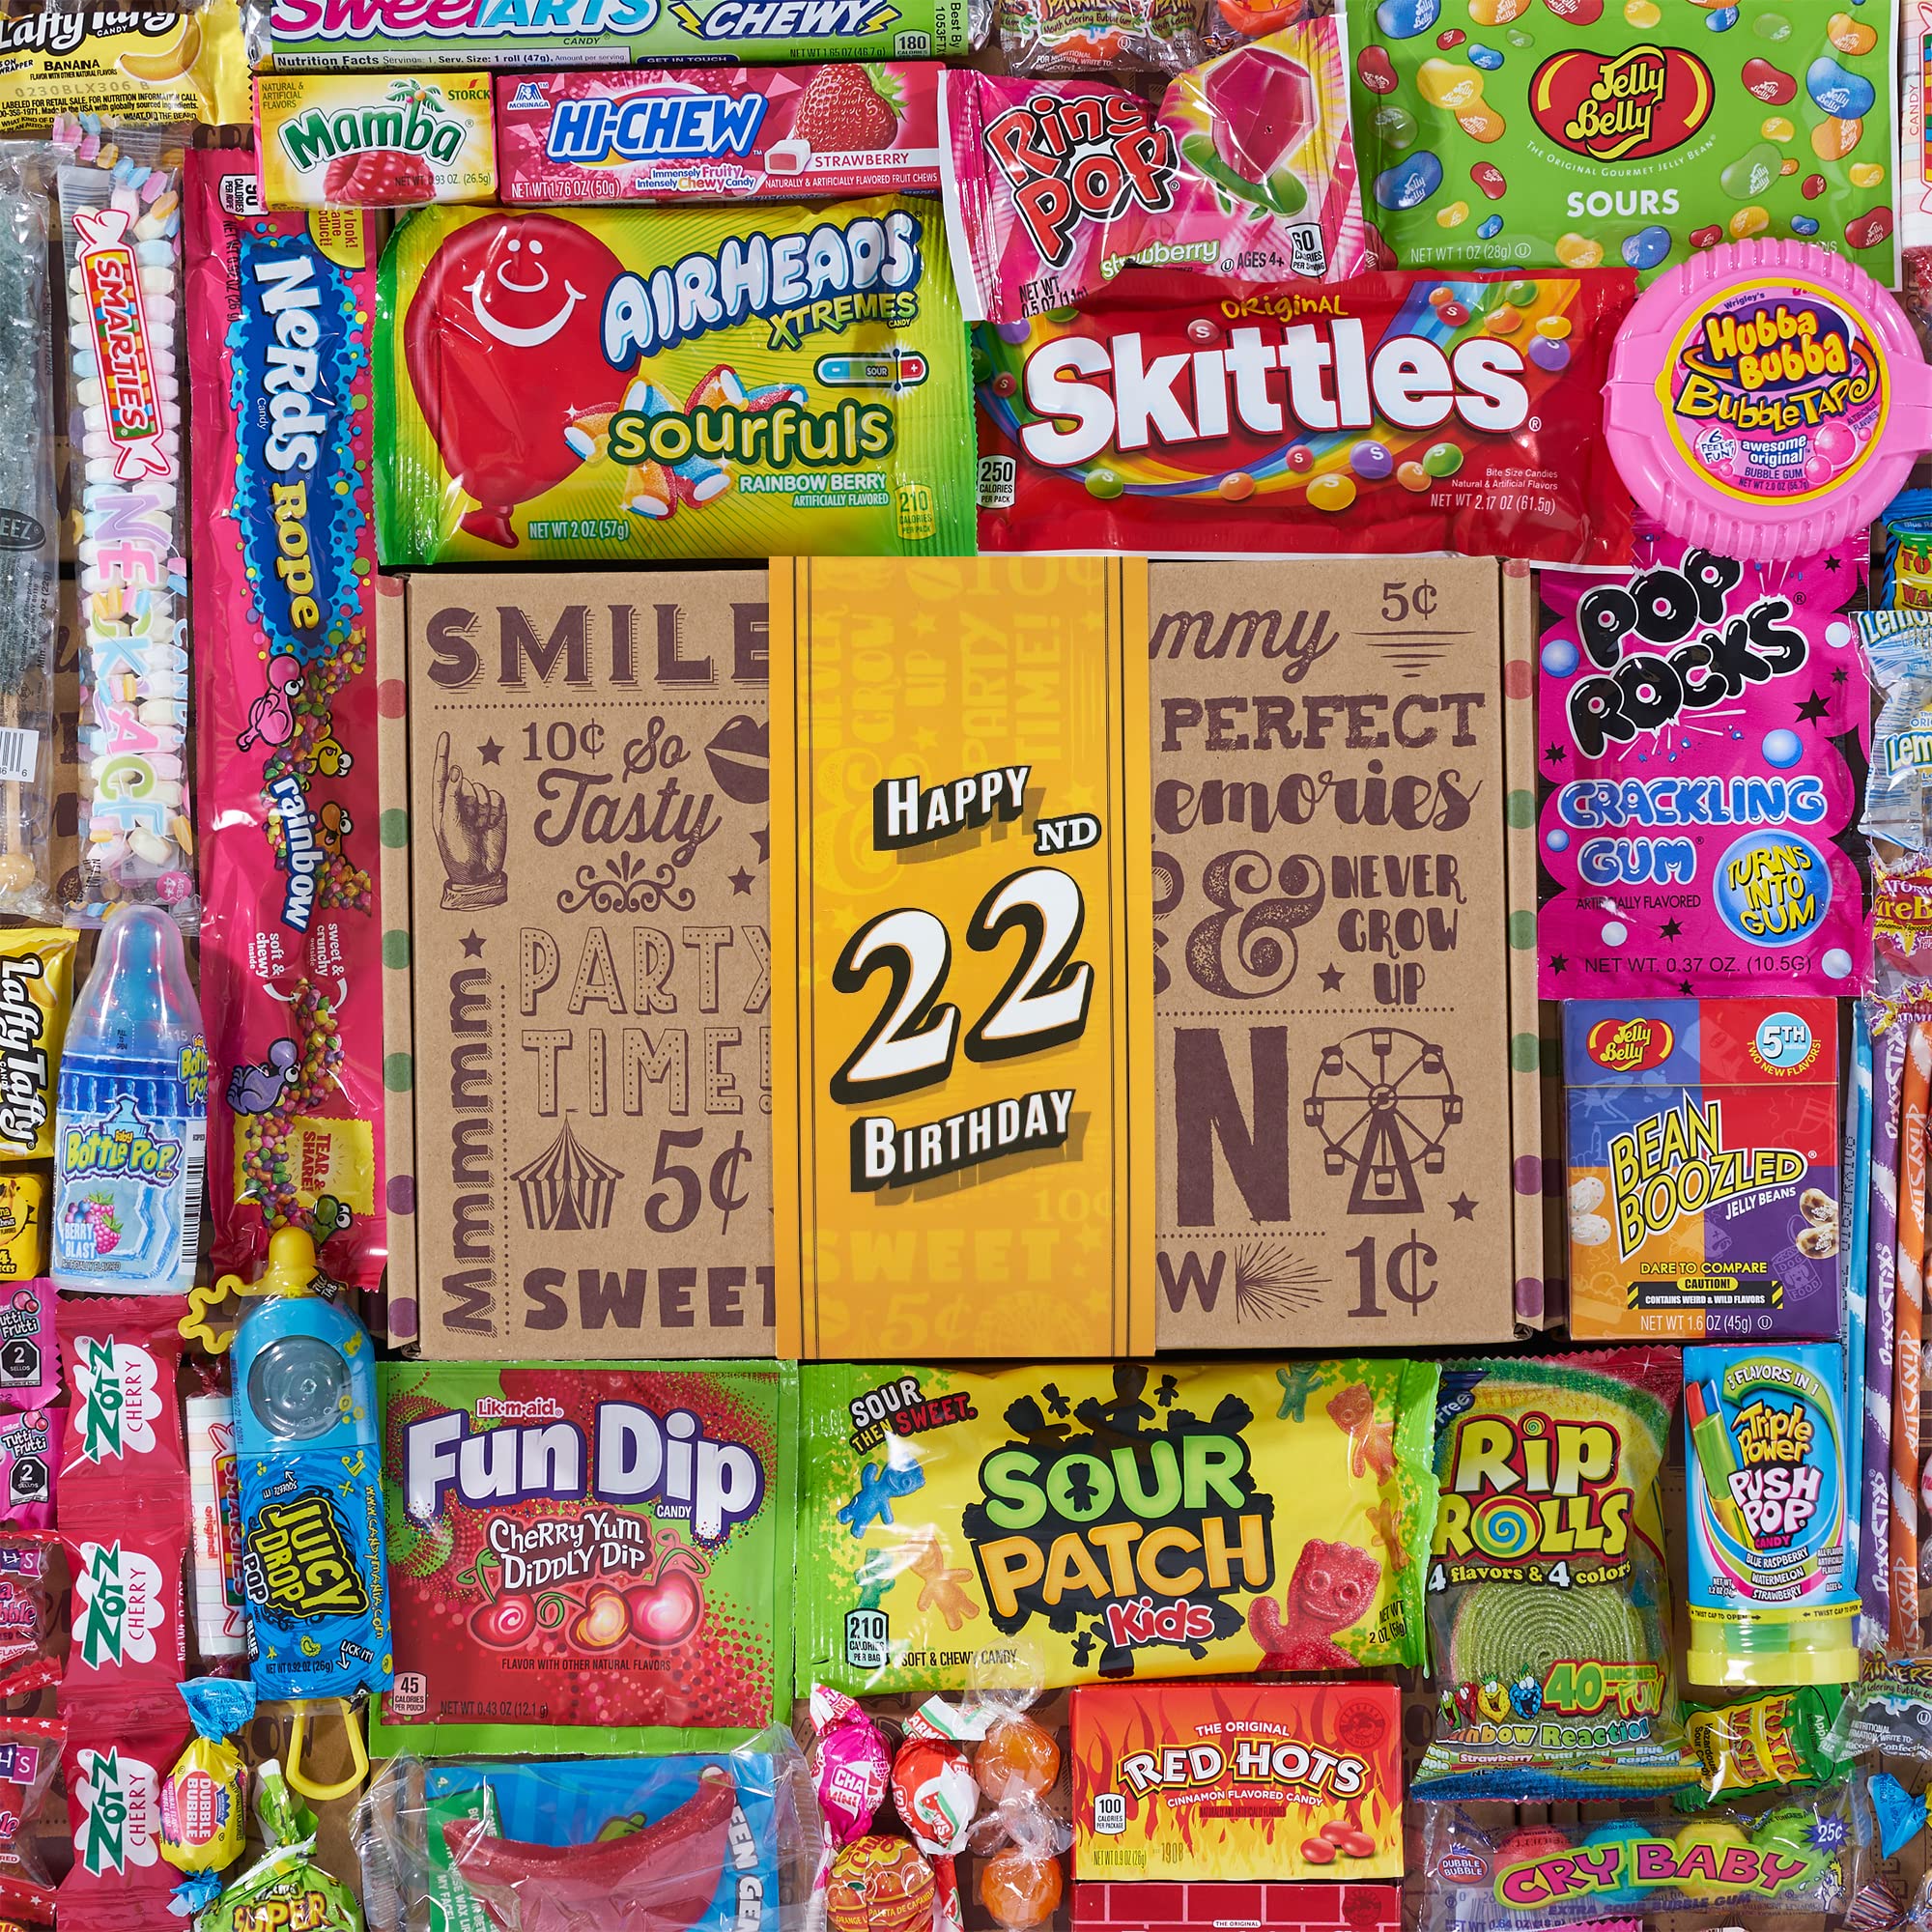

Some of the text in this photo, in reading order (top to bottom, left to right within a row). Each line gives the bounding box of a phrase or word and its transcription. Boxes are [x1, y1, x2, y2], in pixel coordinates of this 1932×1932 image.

[97, 25, 128, 37] CANDY
[705, 0, 873, 38] CHEWY
[43, 59, 100, 71] BANANA
[277, 55, 379, 67] Nutrition Facts
[1592, 45, 1667, 101] Jelly
[448, 89, 491, 101] STORCK
[280, 101, 466, 171] Mamba
[1565, 95, 1655, 161] Belly
[765, 179, 803, 188] NATURALLY
[812, 176, 854, 186] ARTIFICIALLY
[856, 175, 891, 185] FLAVORED
[893, 174, 911, 184] FRUIT
[913, 173, 937, 183] CHEWS
[815, 153, 909, 167] STRAWBERRY
[1567, 189, 1680, 217] SOURS
[1237, 251, 1285, 268] AGES 4+
[604, 211, 916, 364] AIRHEADS
[1723, 292, 1765, 310] Wrigley's
[769, 292, 917, 348] XTREMES
[1706, 306, 1818, 361] Hubba
[94, 261, 147, 430] SMARTIES
[1740, 331, 1848, 390] Bubba
[1021, 319, 1529, 467] Skittles
[613, 404, 893, 465] sourfuls
[1742, 436, 1806, 453] awesome
[740, 473, 887, 492] RAINBOW BERRY
[1745, 468, 1804, 478] BUBBLE GUM
[1749, 450, 1804, 469] original
[1489, 480, 1524, 489] Artificial
[1526, 481, 1558, 490] Flavors
[1380, 579, 1437, 621] 5¢
[1580, 548, 1742, 668] POP
[426, 603, 769, 694] SMILE
[1568, 596, 1808, 757] ROCKS
[1160, 693, 1486, 752] PERFECT
[522, 716, 691, 782] 10¢ So
[534, 768, 723, 867] Tasty
[1559, 778, 1827, 827] CRACKLING
[273, 777, 323, 927] rainbow
[1037, 817, 1097, 852] ND
[1332, 854, 1467, 904] NEVER
[1578, 838, 1696, 885] GUM
[1727, 845, 1812, 890] TURNS
[1740, 904, 1815, 936] GUM
[1744, 882, 1805, 910] INTO
[256, 932, 268, 979] chewy
[270, 933, 280, 976] soft &
[317, 925, 327, 977] crunchy
[328, 923, 339, 976] sweet &
[1338, 908, 1458, 956] GROW
[835, 868, 1092, 1103] 22
[1585, 956, 1811, 974] NET WT. 0.37 OZ. (10.5G)
[0, 952, 47, 1143] Laffy Taffy
[301, 1131, 314, 1191] SHARE!
[315, 1133, 331, 1190] TEAR &
[1609, 1098, 1720, 1201] BEAN
[644, 1126, 753, 1236] 5¢
[1617, 1150, 1805, 1258] BOOZLED
[1725, 1187, 1796, 1220] JELLY BEANS
[64, 1222, 94, 1241] BERRY
[66, 1240, 97, 1259] BLAST
[1346, 1228, 1438, 1317] 1¢
[1640, 1263, 1767, 1273] DARE TO COMPARE
[1684, 1278, 1730, 1290] CAUTION!
[1645, 1295, 1681, 1304] CONTAINS
[1682, 1295, 1706, 1304] WEIRD
[1714, 1295, 1732, 1304] WILD
[1734, 1294, 1765, 1304] FLAVORS
[127, 1360, 142, 1433] CHERRY
[850, 1379, 922, 1429] SOUR
[1727, 1367, 1819, 1395] 3 FLAVORS IN 1
[1731, 1402, 1813, 1440] Triple
[407, 1404, 757, 1539] Fun Dip
[1738, 1431, 1812, 1466] Power
[982, 1435, 1250, 1529] SOUR
[1728, 1467, 1823, 1505] PUSH
[657, 1506, 692, 1519] CANDY
[1432, 1491, 1633, 1555] ROLLS
[1743, 1499, 1814, 1536] POP
[243, 1552, 268, 1605] POP
[255, 1531, 305, 1603] DROP
[269, 1505, 359, 1608] JUICY
[977, 1515, 1266, 1619] PATCH
[1428, 1562, 1631, 1591] 4 flavors & 4 colors
[1746, 1548, 1809, 1568] BLUE RASPBERRY
[1751, 1568, 1804, 1585] WATERMELON
[1752, 1585, 1802, 1601] STRAWBERRY
[1105, 1598, 1215, 1648] Kids
[501, 1659, 671, 1670] FLAVOR WITH OTHER NATURAL FLAVORS
[1543, 1662, 1602, 1710] 40
[1196, 1721, 1290, 1737] THE ORIGINAL
[1542, 1719, 1650, 1748] Reaction
[1730, 1708, 1768, 1780] WASTE
[1765, 1699, 1800, 1777] TOXIC
[1122, 1742, 1368, 1792] RED HOTS
[130, 1774, 146, 1847] CHERRY
[187, 1777, 198, 1838] BUBBLE
[200, 1777, 211, 1837] DUBBLE
[1168, 1791, 1322, 1807] CINNAMON FLAVORED CANDY
[1501, 1844, 1808, 1905] CRY BABY
